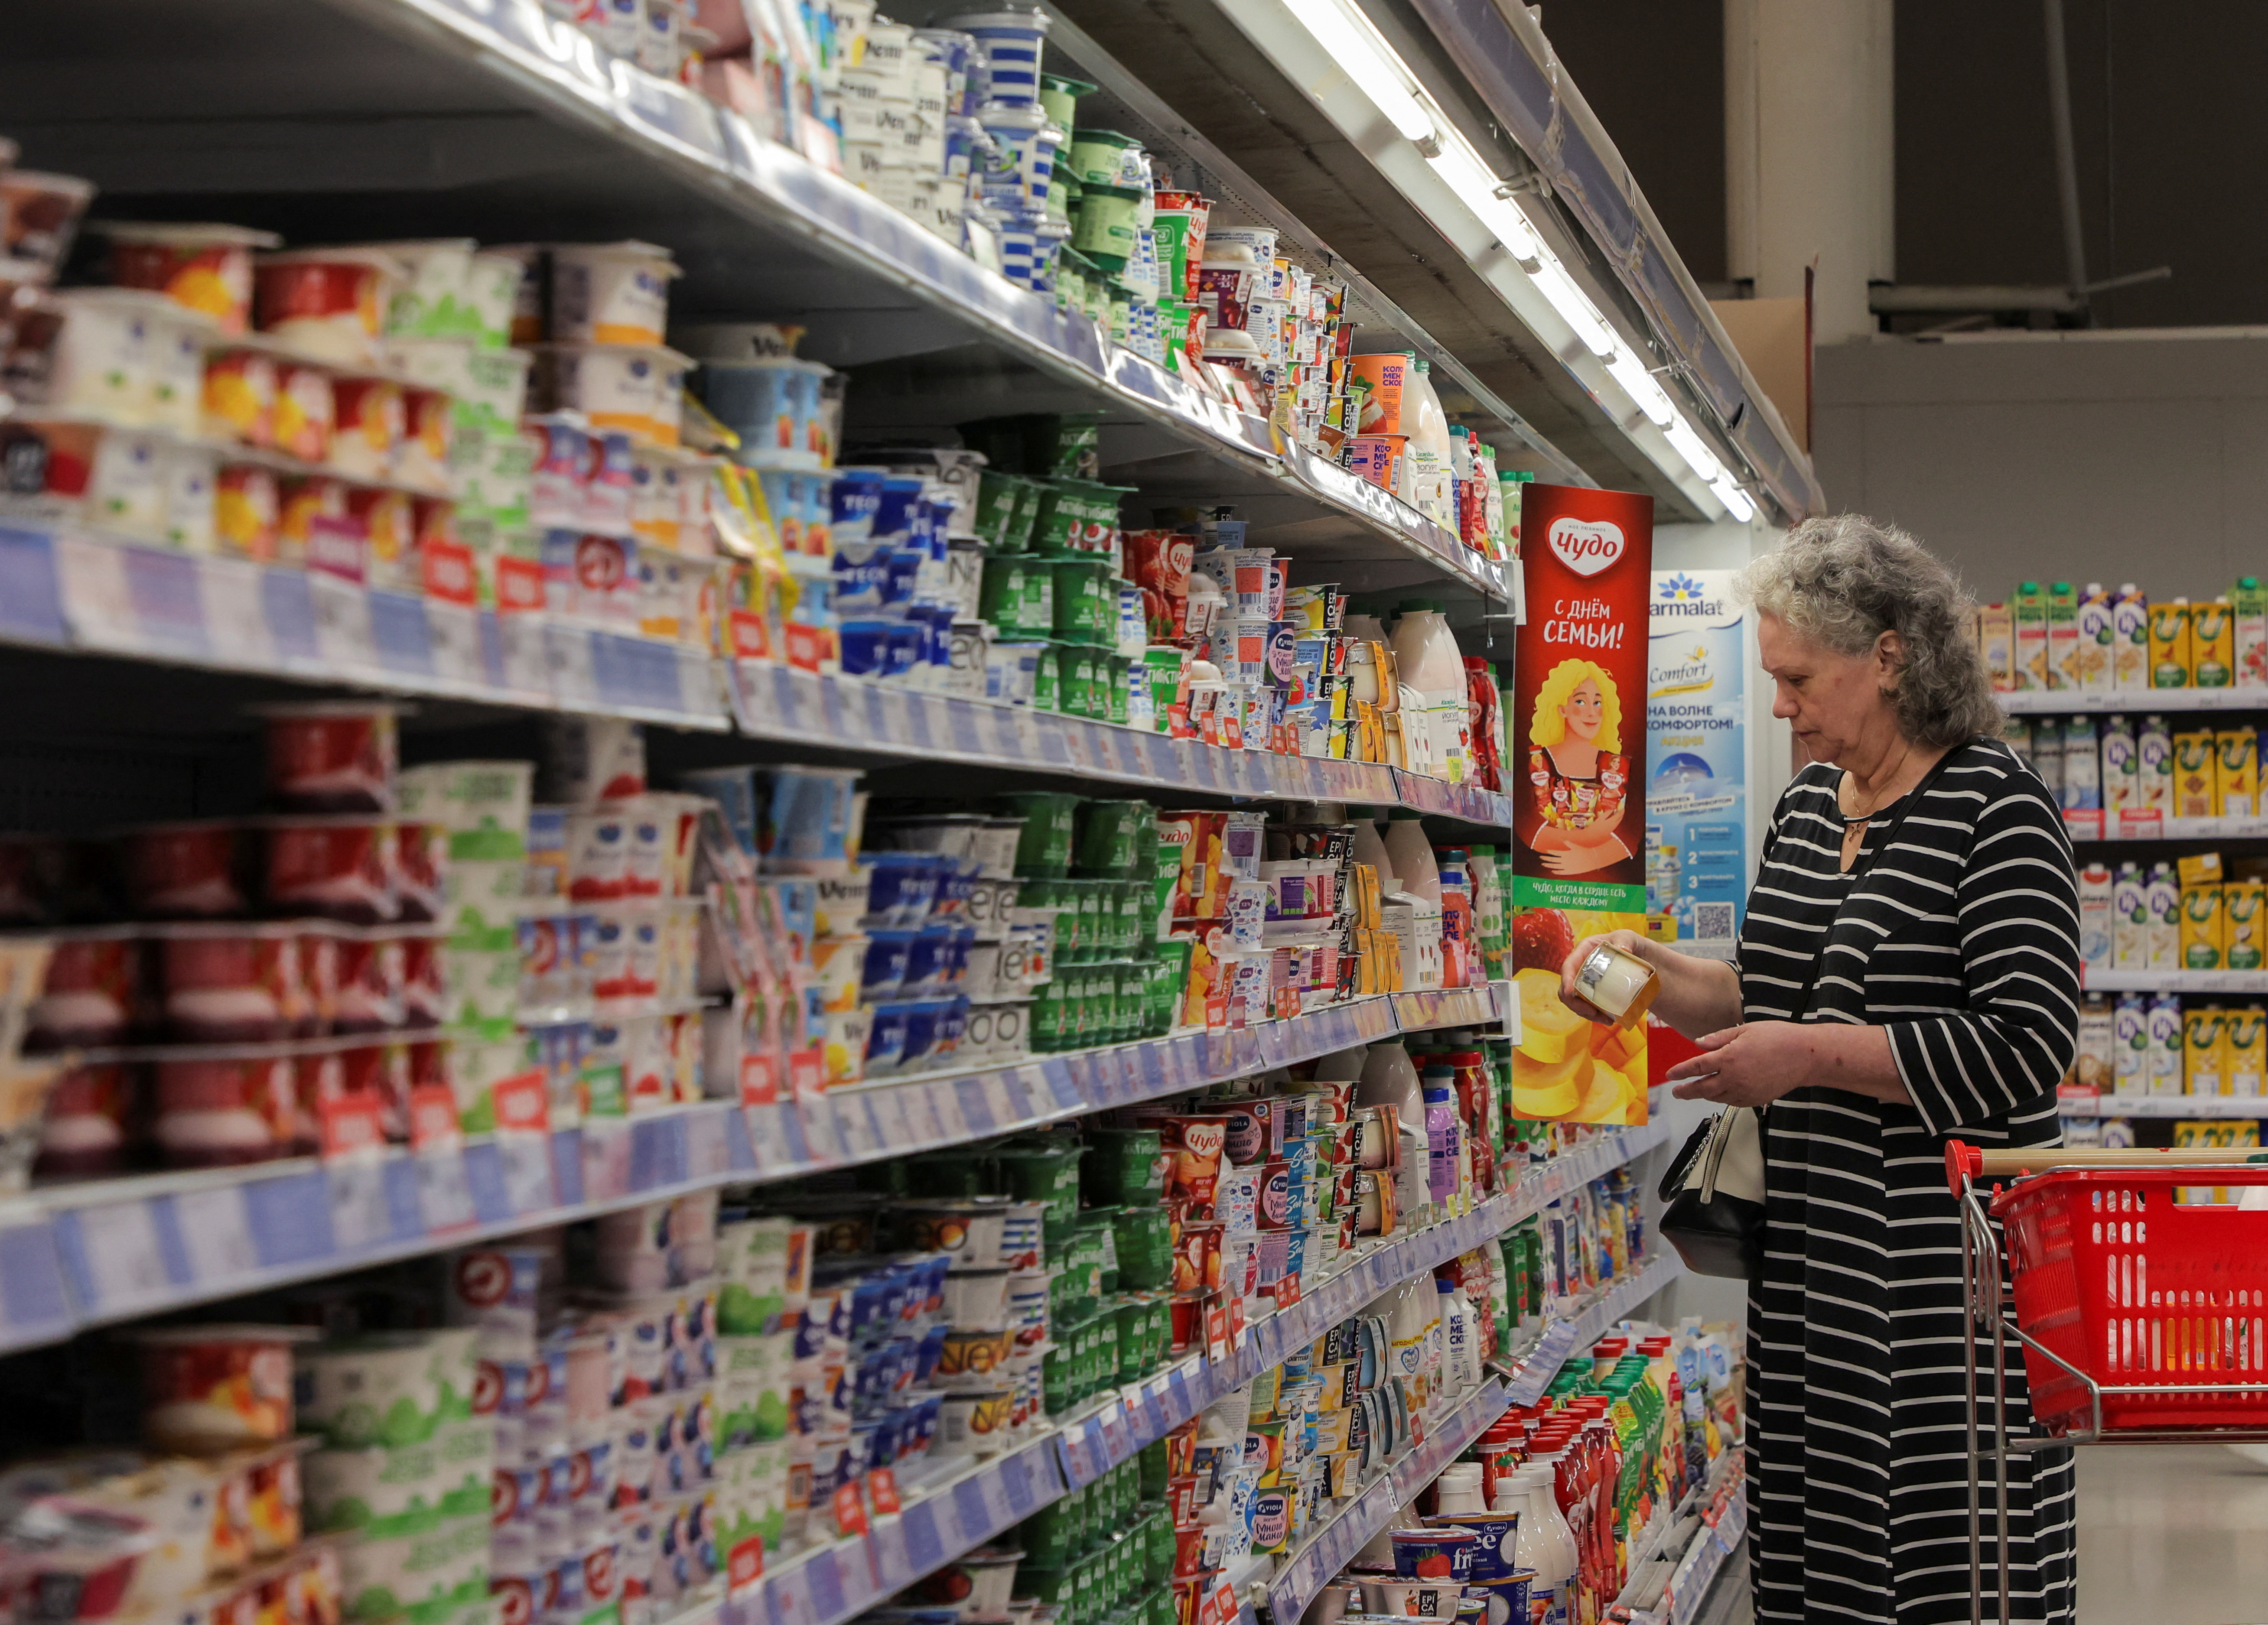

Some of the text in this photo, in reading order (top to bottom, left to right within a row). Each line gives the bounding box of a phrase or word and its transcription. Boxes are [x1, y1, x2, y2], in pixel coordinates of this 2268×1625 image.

[1557, 532, 1617, 561] Чудо
[1555, 598, 1610, 620] С ДНЁМ
[1649, 600, 1724, 616] armalat
[1544, 620, 1624, 649] СЕМЬИ!
[1650, 662, 1707, 683] Comfort
[1648, 705, 1713, 716] НА ВОЛНЕ
[1689, 828, 1695, 841] 1
[1688, 852, 1698, 864] 2
[1533, 881, 1627, 897] ЧУДО, КОГДА В СЕРДЦЕ ЕСТЬ
[1689, 875, 1698, 889] 3
[1550, 895, 1608, 907] МЕСТО КАЖДОМУ
[1191, 1134, 1222, 1152] Чудо
[1256, 1523, 1282, 1534] Много
[1473, 1534, 1497, 1550] ee
[1422, 1595, 1435, 1604] EPI
[1421, 1604, 1435, 1612] CA
